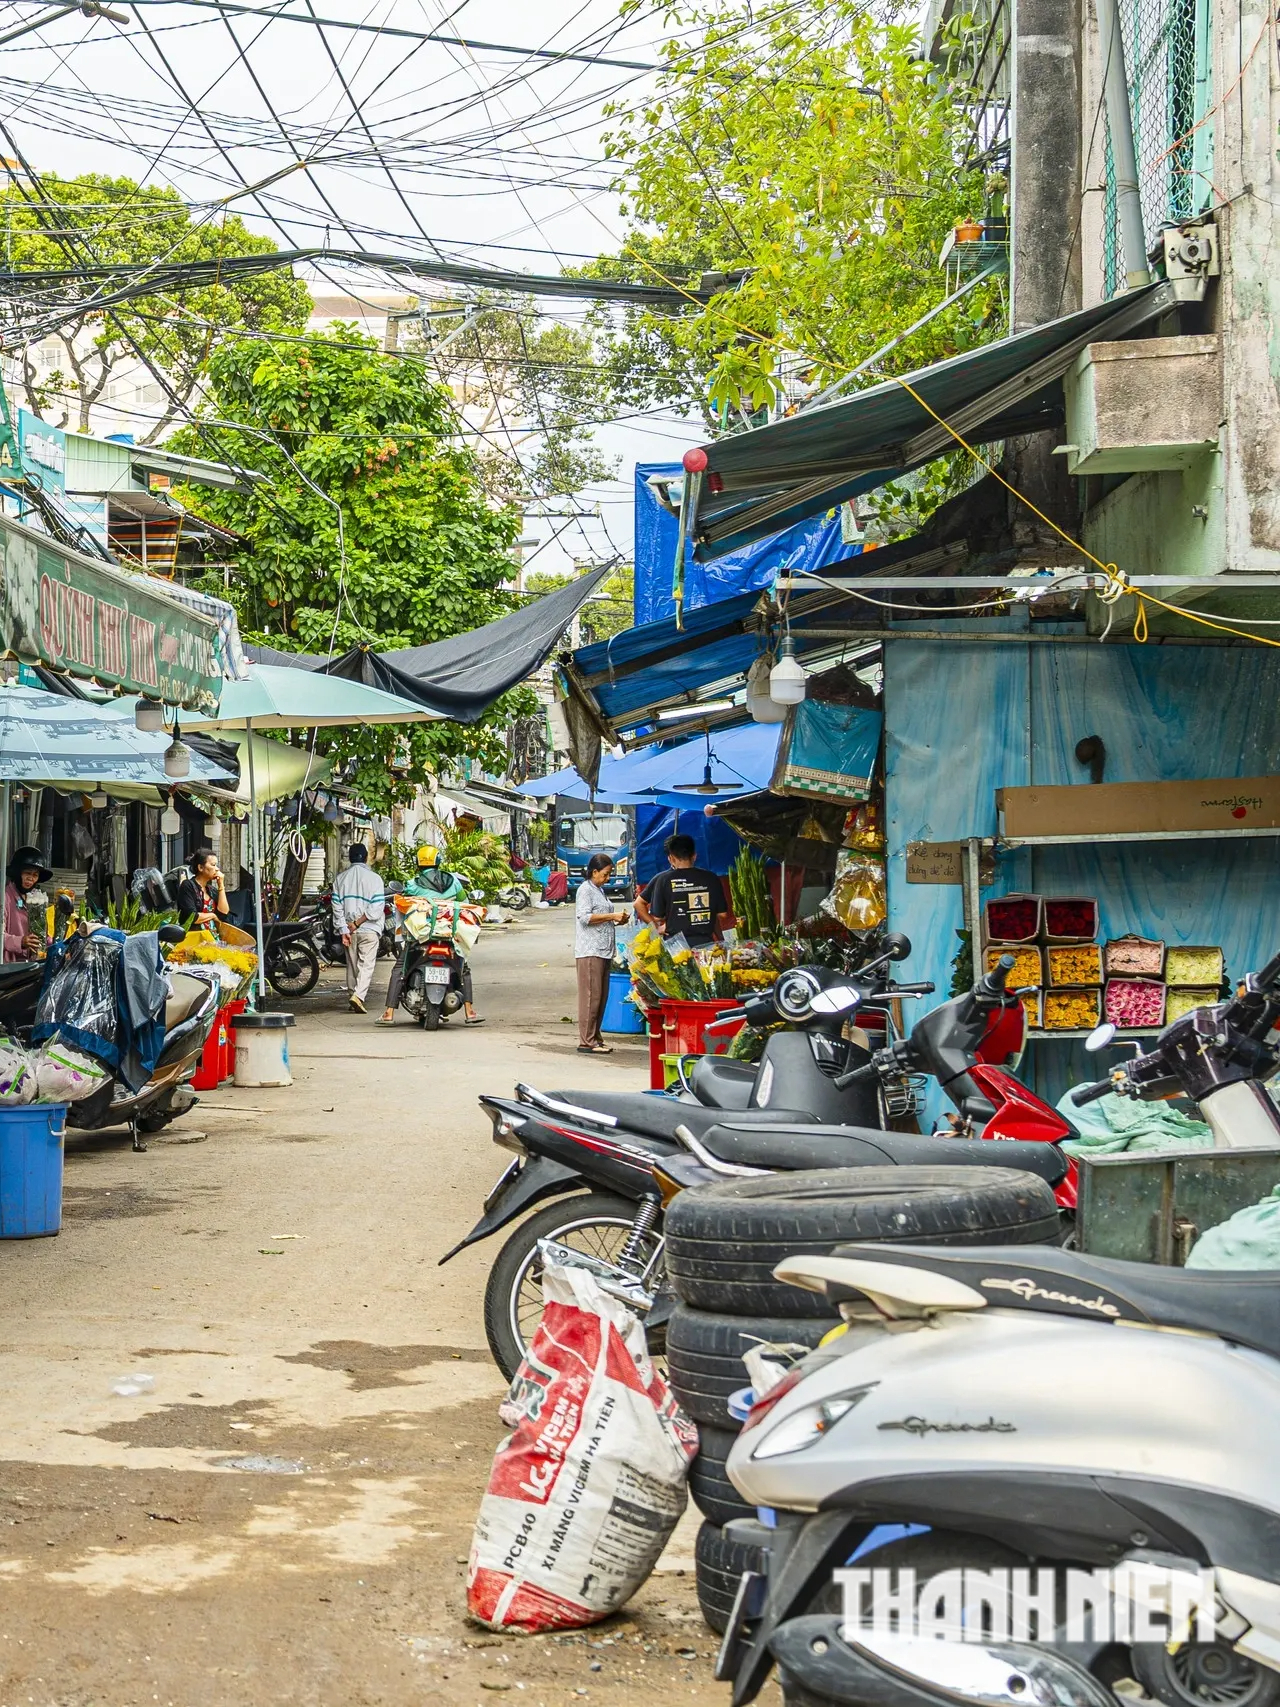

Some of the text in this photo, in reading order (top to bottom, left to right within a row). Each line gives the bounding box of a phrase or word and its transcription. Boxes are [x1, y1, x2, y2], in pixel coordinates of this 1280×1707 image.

[981, 1278, 1121, 1317] Grande
[533, 1396, 570, 1454] VICEM
[876, 1416, 1018, 1438] Grande
[503, 1512, 537, 1570] PCB40
[541, 1554, 556, 1572] XI
[567, 1458, 592, 1504] VICEM
